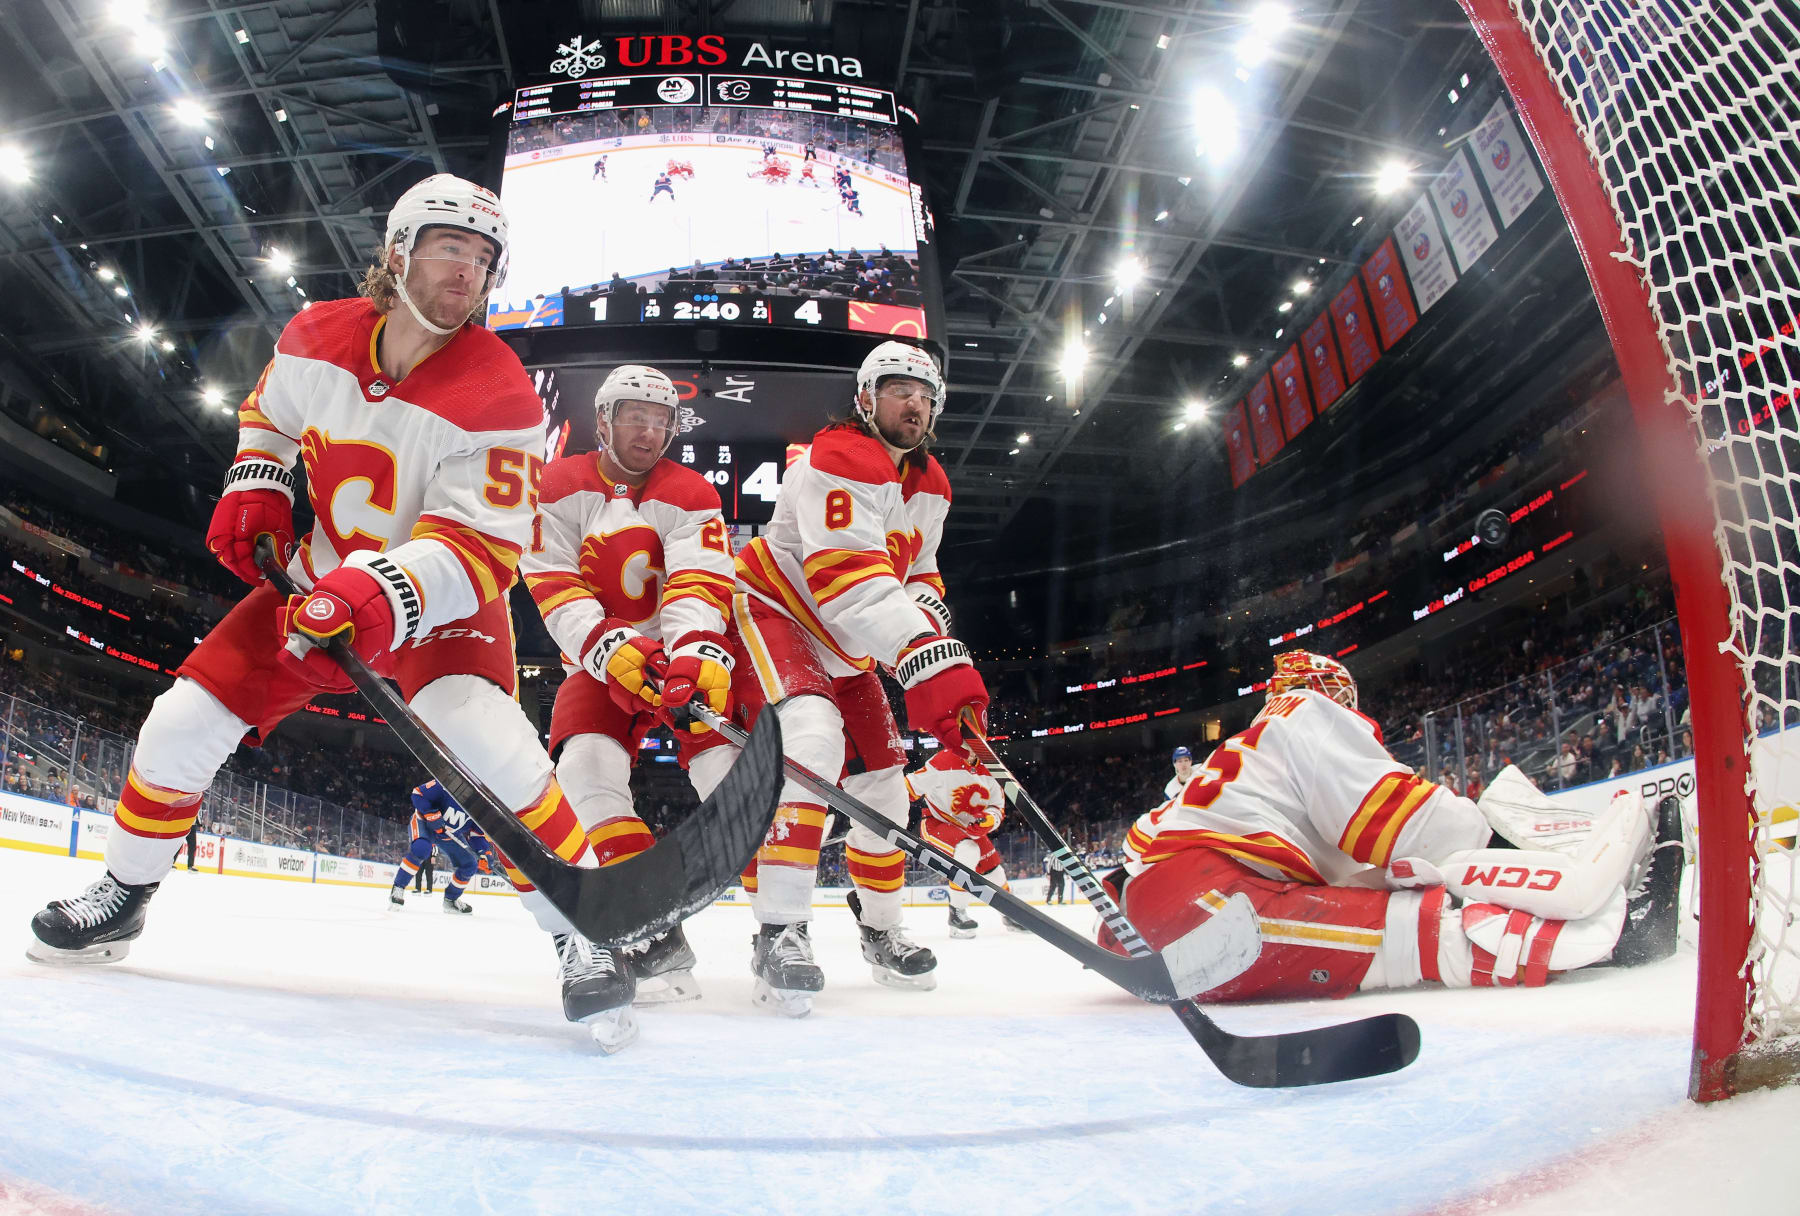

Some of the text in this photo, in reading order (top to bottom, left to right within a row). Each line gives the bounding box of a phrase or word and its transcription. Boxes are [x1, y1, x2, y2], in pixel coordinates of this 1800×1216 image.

[615, 35, 863, 78] UBS Arena
[471, 202, 501, 218] CCM
[590, 297, 608, 321] 1
[673, 301, 740, 320] 2:40
[752, 306, 768, 319] 23
[794, 300, 822, 324] 4
[647, 383, 670, 392] CCM
[682, 452, 732, 464] 29 23
[742, 462, 783, 502] 4
[825, 488, 854, 532] 8
[12, 560, 26, 574] Best
[36, 573, 51, 587] Ever?
[64, 590, 82, 602] ZERO
[82, 596, 103, 611] SUGAR
[1413, 605, 1430, 621] Best
[1443, 587, 1464, 606] Ever?
[1468, 576, 1487, 593] Coke
[1486, 565, 1508, 584] ZERO
[1508, 550, 1536, 574] SUGAR
[66, 626, 80, 638] Best
[89, 637, 105, 650] Ever?
[106, 646, 120, 658] Coke
[120, 650, 138, 664] ZERO
[138, 656, 160, 672] SUGAR
[410, 628, 496, 649] CCM
[698, 644, 733, 671] CC
[898, 642, 972, 686] WARRIOR
[670, 683, 691, 694] CCM
[1066, 684, 1082, 694] Best
[1096, 678, 1116, 689] Ever?
[1238, 686, 1253, 697] Best
[305, 703, 322, 713] Coke
[1032, 729, 1048, 737] Best
[1048, 727, 1064, 735] Coke
[1064, 724, 1084, 733] Ever?
[1090, 720, 1106, 729] Coke
[1108, 717, 1124, 727] ZERO
[1126, 712, 1148, 724] SUGAR
[39, 818, 54, 828] 98.7
[1533, 819, 1592, 832] CCM
[278, 855, 304, 872] verizon
[886, 828, 998, 905] CCM
[1461, 865, 1563, 892] CCM
